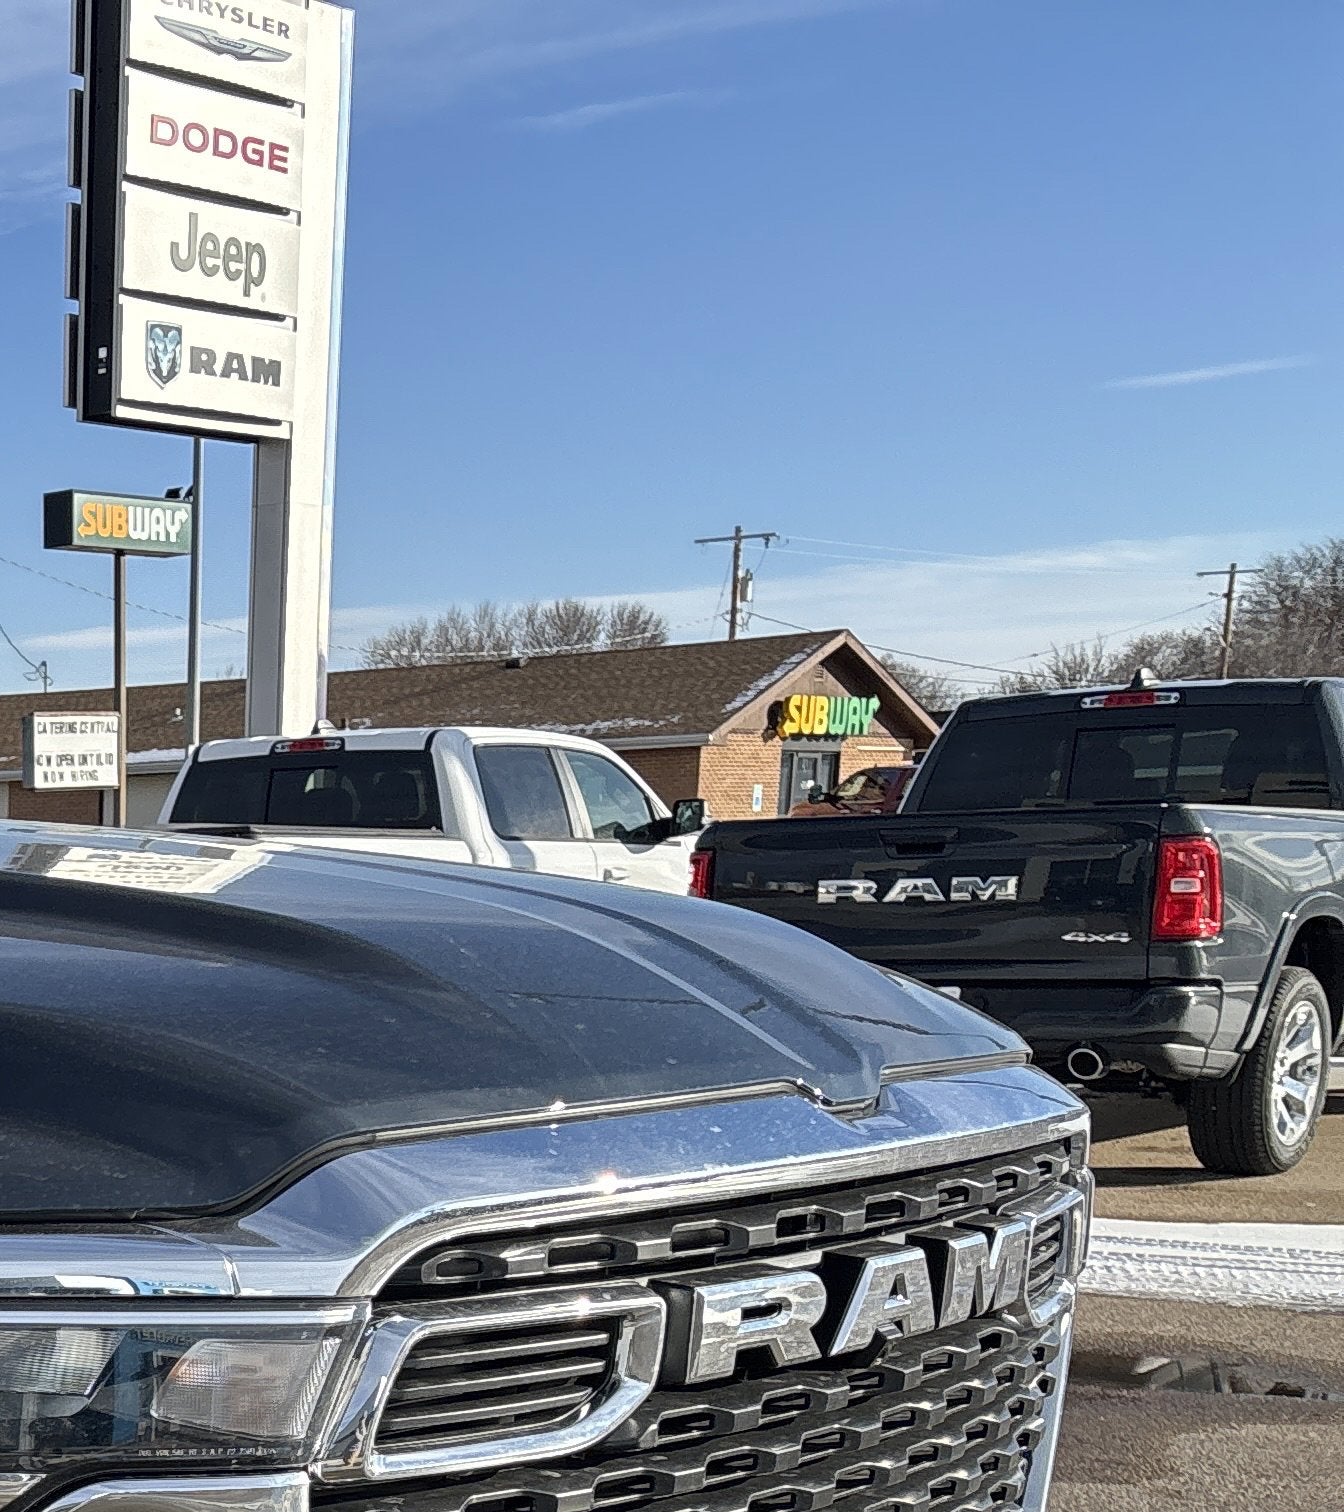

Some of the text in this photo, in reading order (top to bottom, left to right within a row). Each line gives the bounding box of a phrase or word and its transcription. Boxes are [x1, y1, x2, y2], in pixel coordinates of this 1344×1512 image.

[150, 113, 290, 175] DODGE
[170, 212, 267, 297] Jeep
[189, 345, 282, 387] RAM
[78, 502, 189, 543] SUBWAY
[782, 694, 881, 736] SUBWAY
[816, 875, 1019, 903] RAM
[685, 1218, 1030, 1385] RAM
